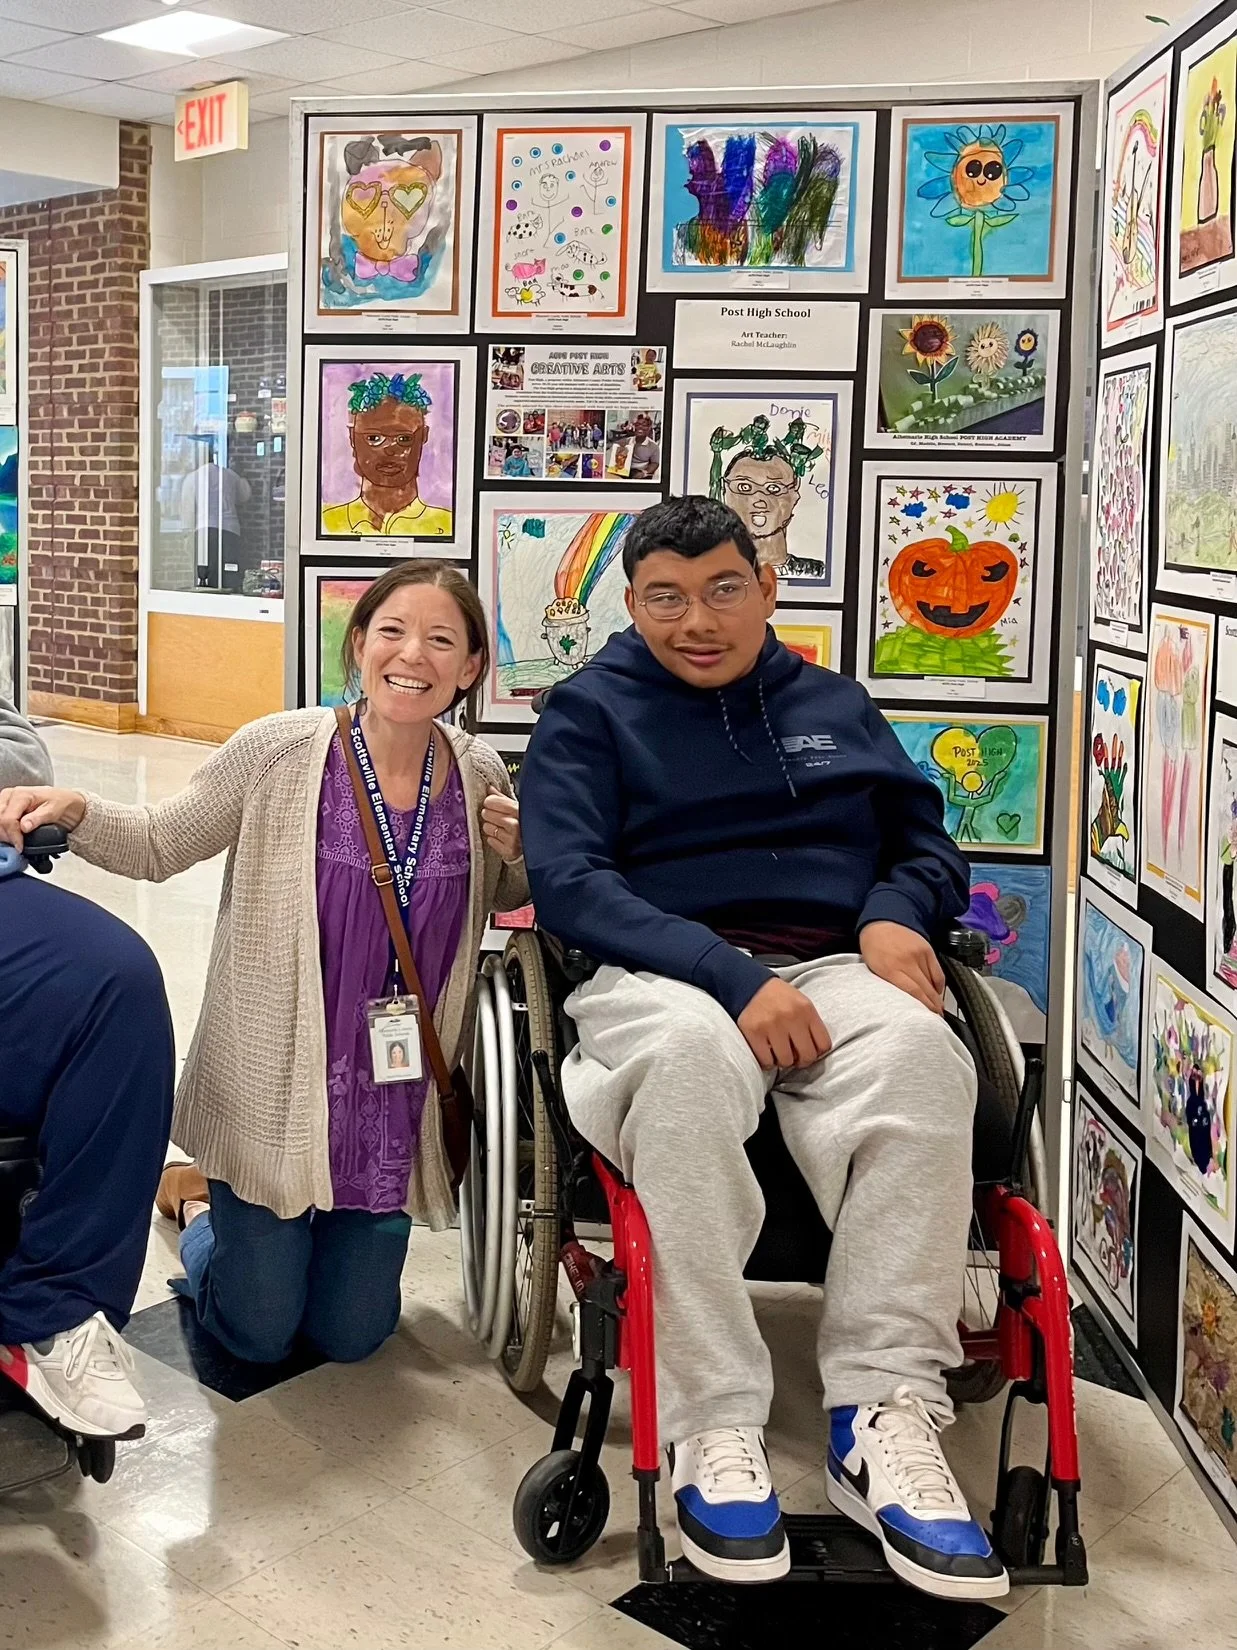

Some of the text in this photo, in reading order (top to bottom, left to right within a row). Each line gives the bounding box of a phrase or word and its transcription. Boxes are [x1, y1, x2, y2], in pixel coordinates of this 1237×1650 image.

[185, 92, 226, 151] EXIT
[721, 306, 811, 320] Post High School
[741, 331, 788, 339] Art Teacher:
[731, 340, 797, 350] Rachel McLaughlin
[569, 351, 588, 360] POST
[530, 361, 627, 376] CREATIVE ARTS
[1000, 617, 1019, 627] Mia
[952, 746, 977, 758] POST
[966, 758, 989, 767] 2025
[350, 726, 410, 907] Scottsville Elementary School
[407, 785, 430, 854] Elementary
